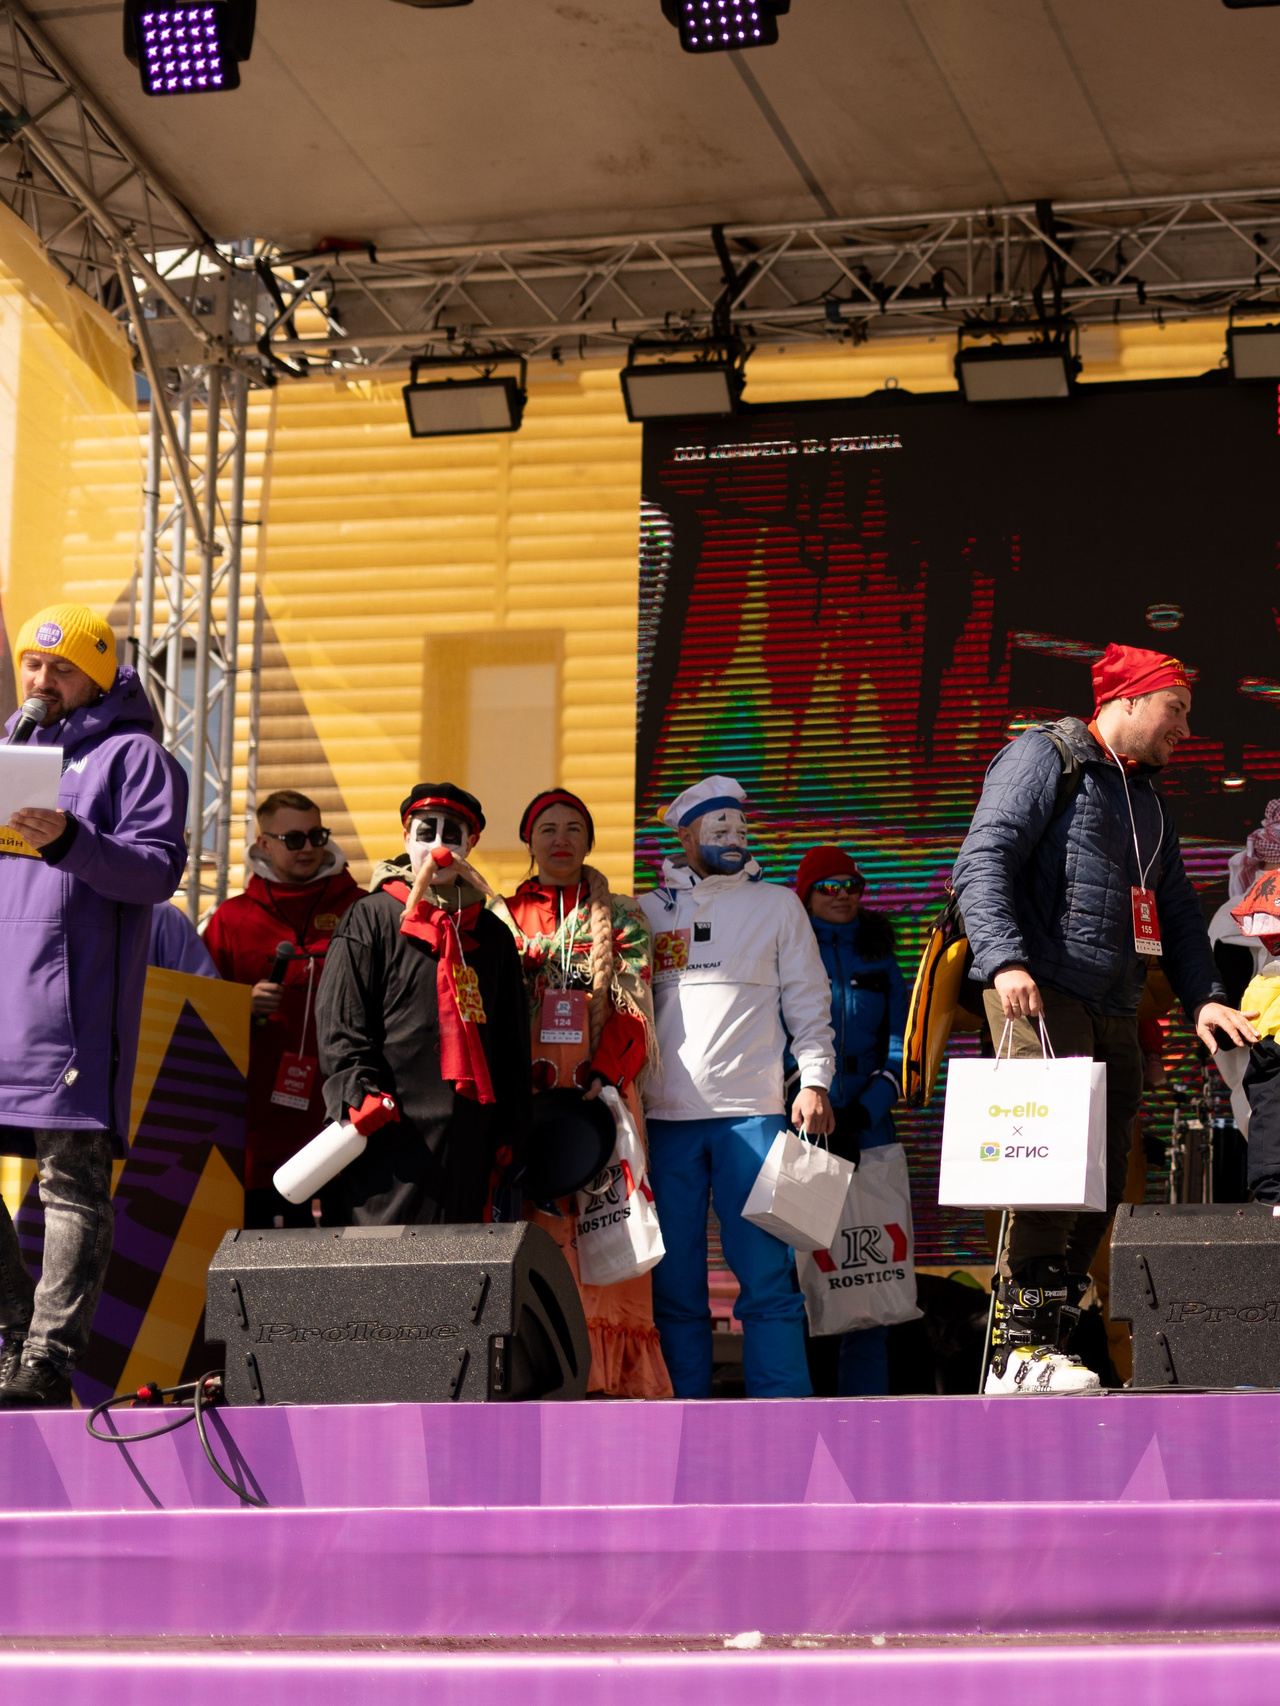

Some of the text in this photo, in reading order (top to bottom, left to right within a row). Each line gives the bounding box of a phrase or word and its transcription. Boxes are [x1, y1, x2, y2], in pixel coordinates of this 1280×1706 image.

[1141, 925, 1153, 934] 155
[554, 1018, 571, 1026] 124
[1004, 1145, 1049, 1158] 2ГИС
[841, 1225, 887, 1269] R
[828, 1268, 905, 1290] ROSTIC'S
[256, 1321, 460, 1344] ProTone
